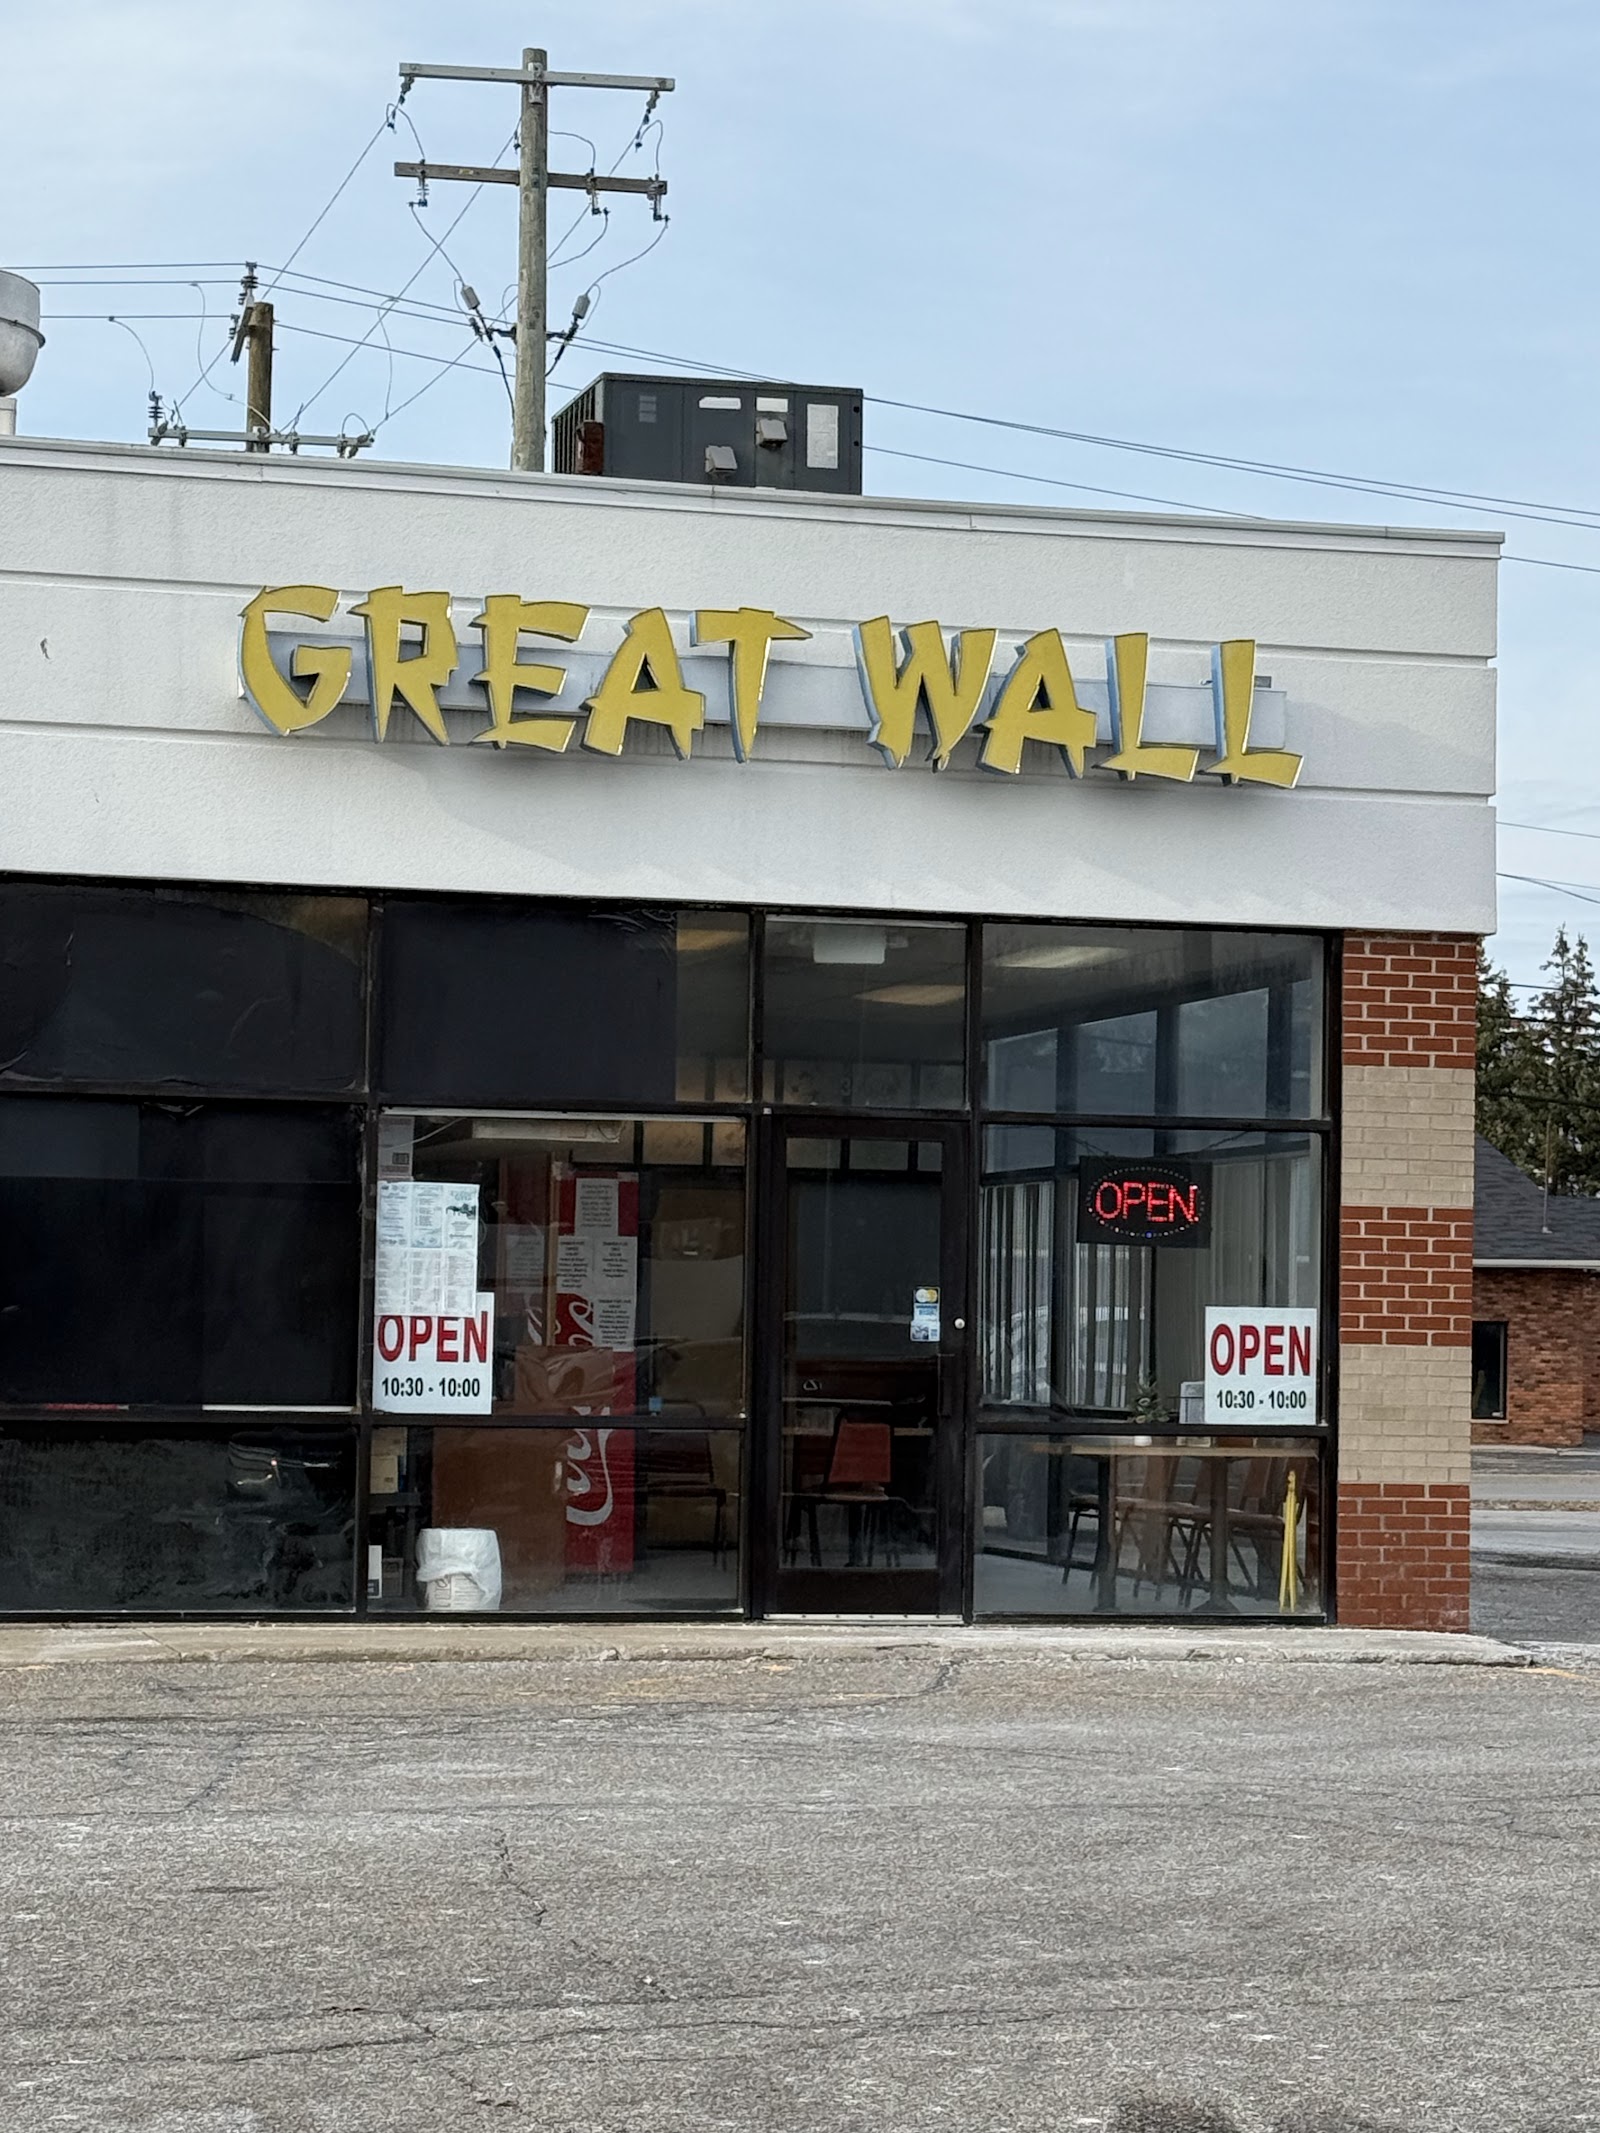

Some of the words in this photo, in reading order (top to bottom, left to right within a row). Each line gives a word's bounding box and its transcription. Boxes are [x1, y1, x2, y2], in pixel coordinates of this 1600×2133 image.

[239, 585, 811, 763] GREAT
[856, 616, 1303, 790] WALL
[1094, 1181, 1199, 1223] OPEN
[378, 1311, 488, 1363] OPEN
[1210, 1323, 1311, 1376] OPEN
[381, 1377, 424, 1397] 10:30
[439, 1377, 481, 1397] 10:00
[1215, 1389, 1256, 1409] 10:30
[1267, 1389, 1308, 1409] 10:00
